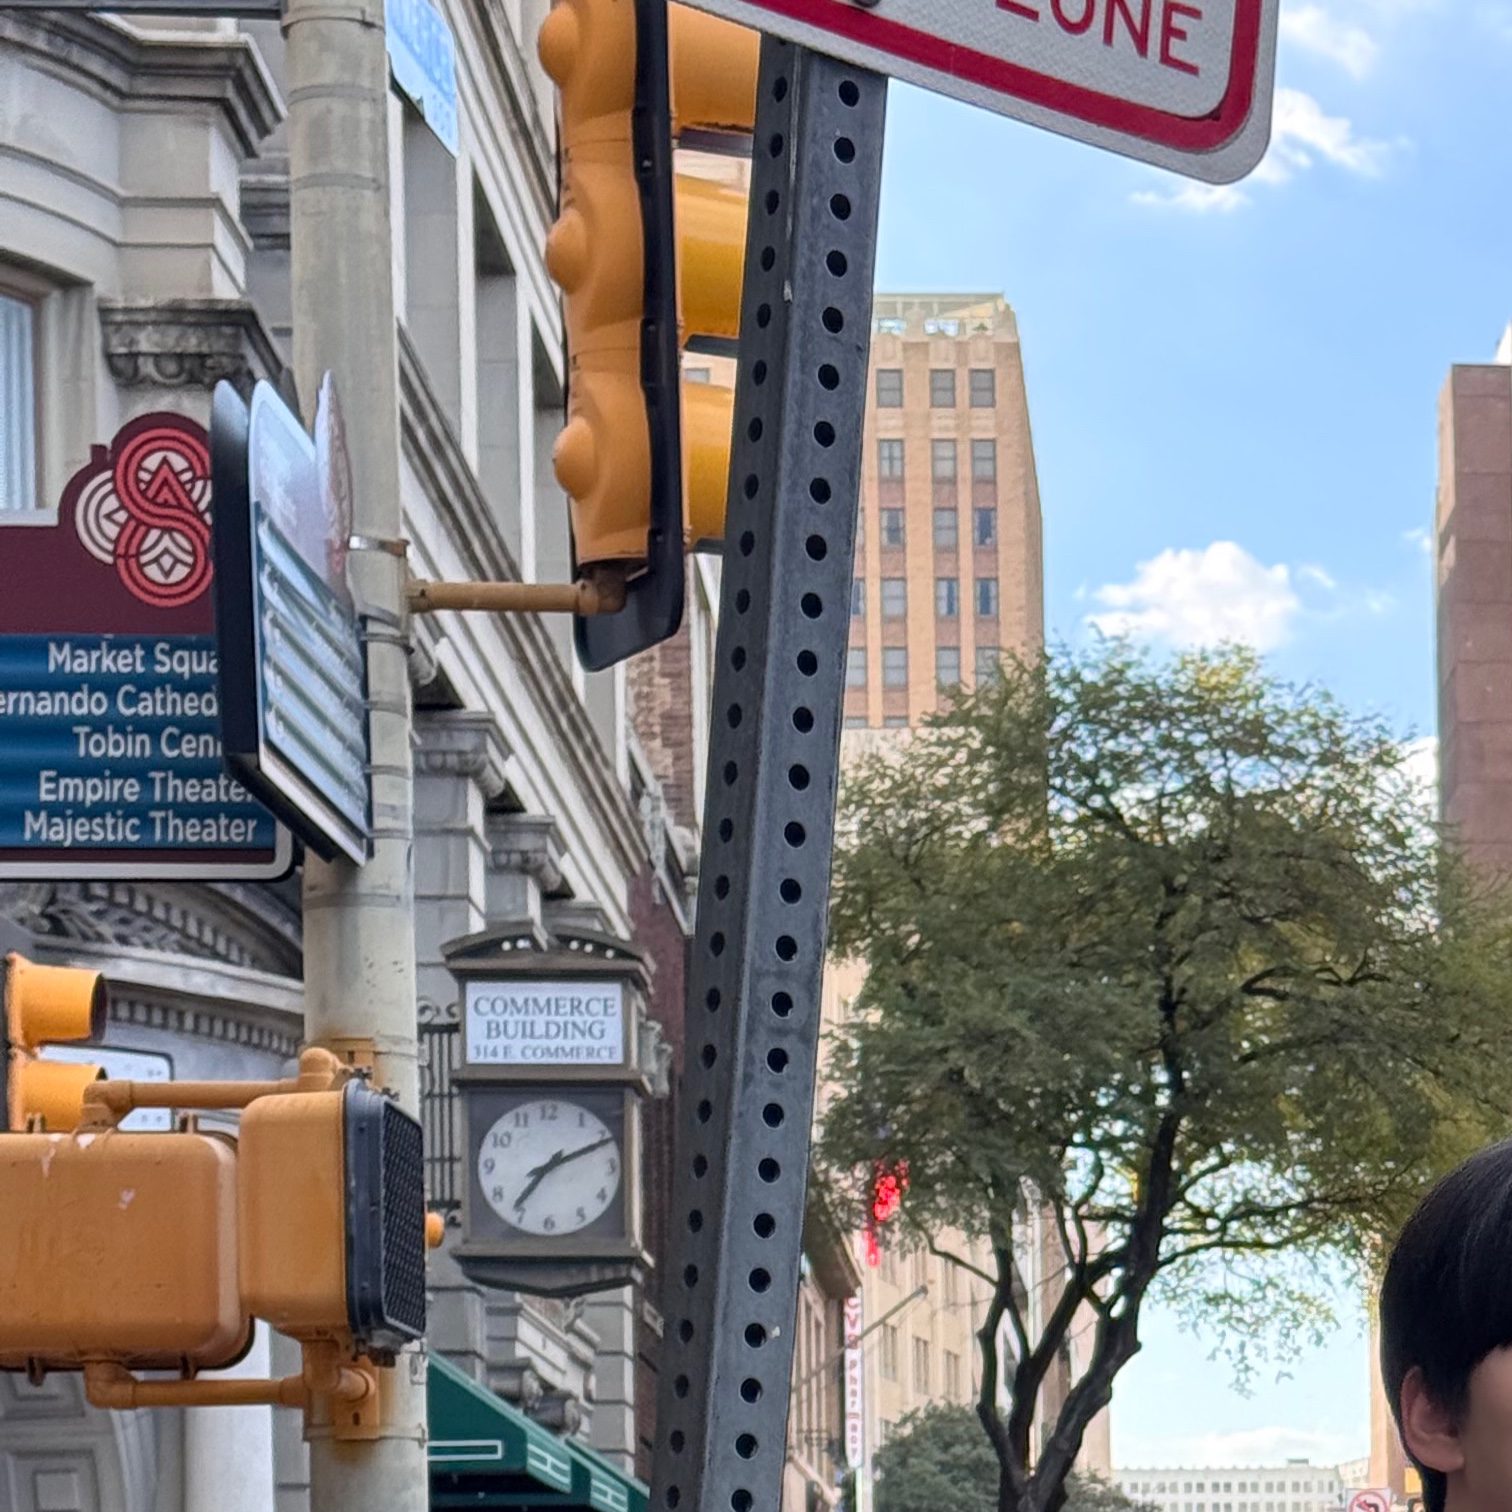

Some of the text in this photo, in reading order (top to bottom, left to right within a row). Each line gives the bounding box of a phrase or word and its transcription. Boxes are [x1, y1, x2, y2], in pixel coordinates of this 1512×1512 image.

[48, 641, 219, 680] Market Squa
[0, 684, 218, 717] rnando Cathed
[72, 726, 221, 758] Tobin Cen
[38, 770, 140, 807] Empire
[24, 810, 258, 847] Majestic Theater
[473, 996, 617, 1018] COMMERCE
[485, 1020, 606, 1041] BUILDING
[520, 1045, 617, 1060] COMMERCE
[514, 1112, 528, 1128] 11
[541, 1104, 558, 1121] 12
[577, 1112, 585, 1128] 1
[492, 1131, 512, 1149] 10
[483, 1157, 496, 1175] 9
[492, 1185, 504, 1203] 8
[596, 1187, 608, 1203] 4
[543, 1216, 555, 1232] 6
[575, 1206, 586, 1224] 5
